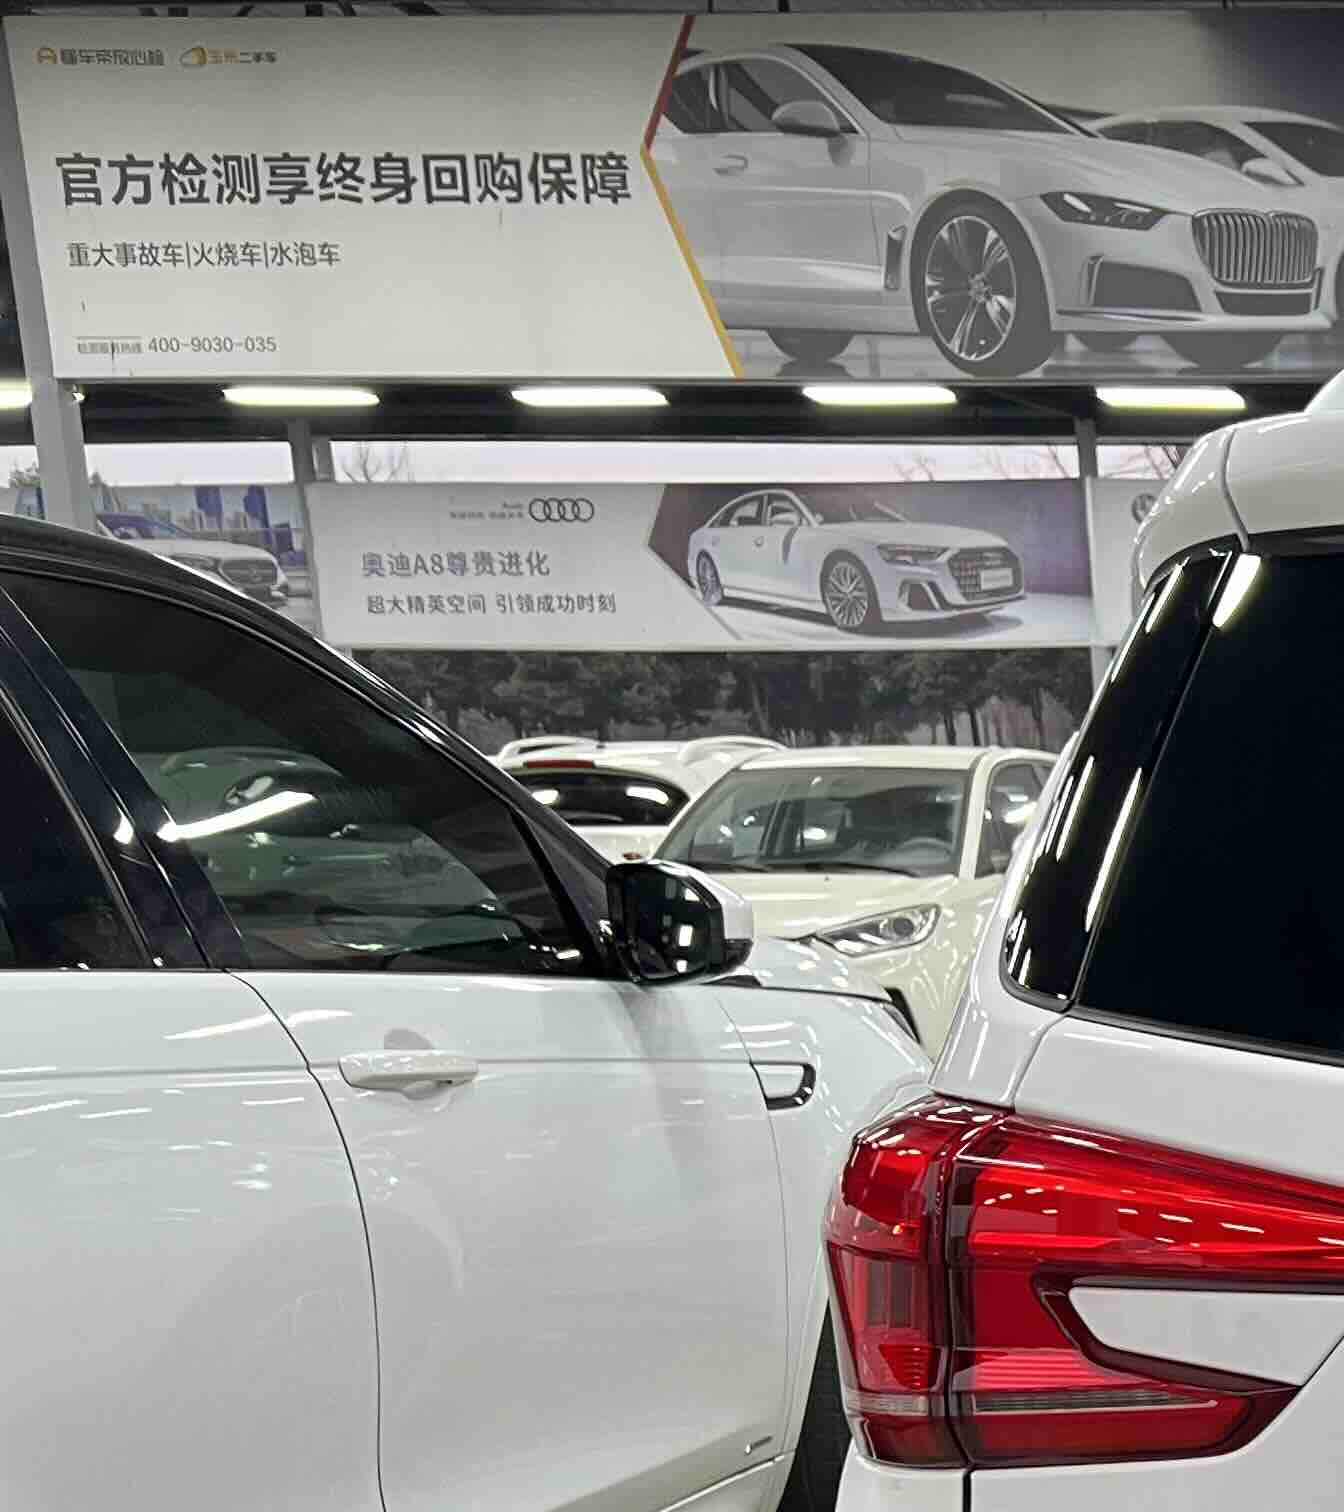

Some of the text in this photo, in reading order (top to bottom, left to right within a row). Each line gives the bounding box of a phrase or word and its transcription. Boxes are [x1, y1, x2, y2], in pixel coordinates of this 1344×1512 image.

[55, 151, 632, 206] 官方检测享终身回购保障
[148, 336, 278, 353] 400-9030-035
[361, 550, 550, 577] 奥迪A8尊贵进化
[366, 592, 617, 615] 超大精英空间 引领成功时刻
